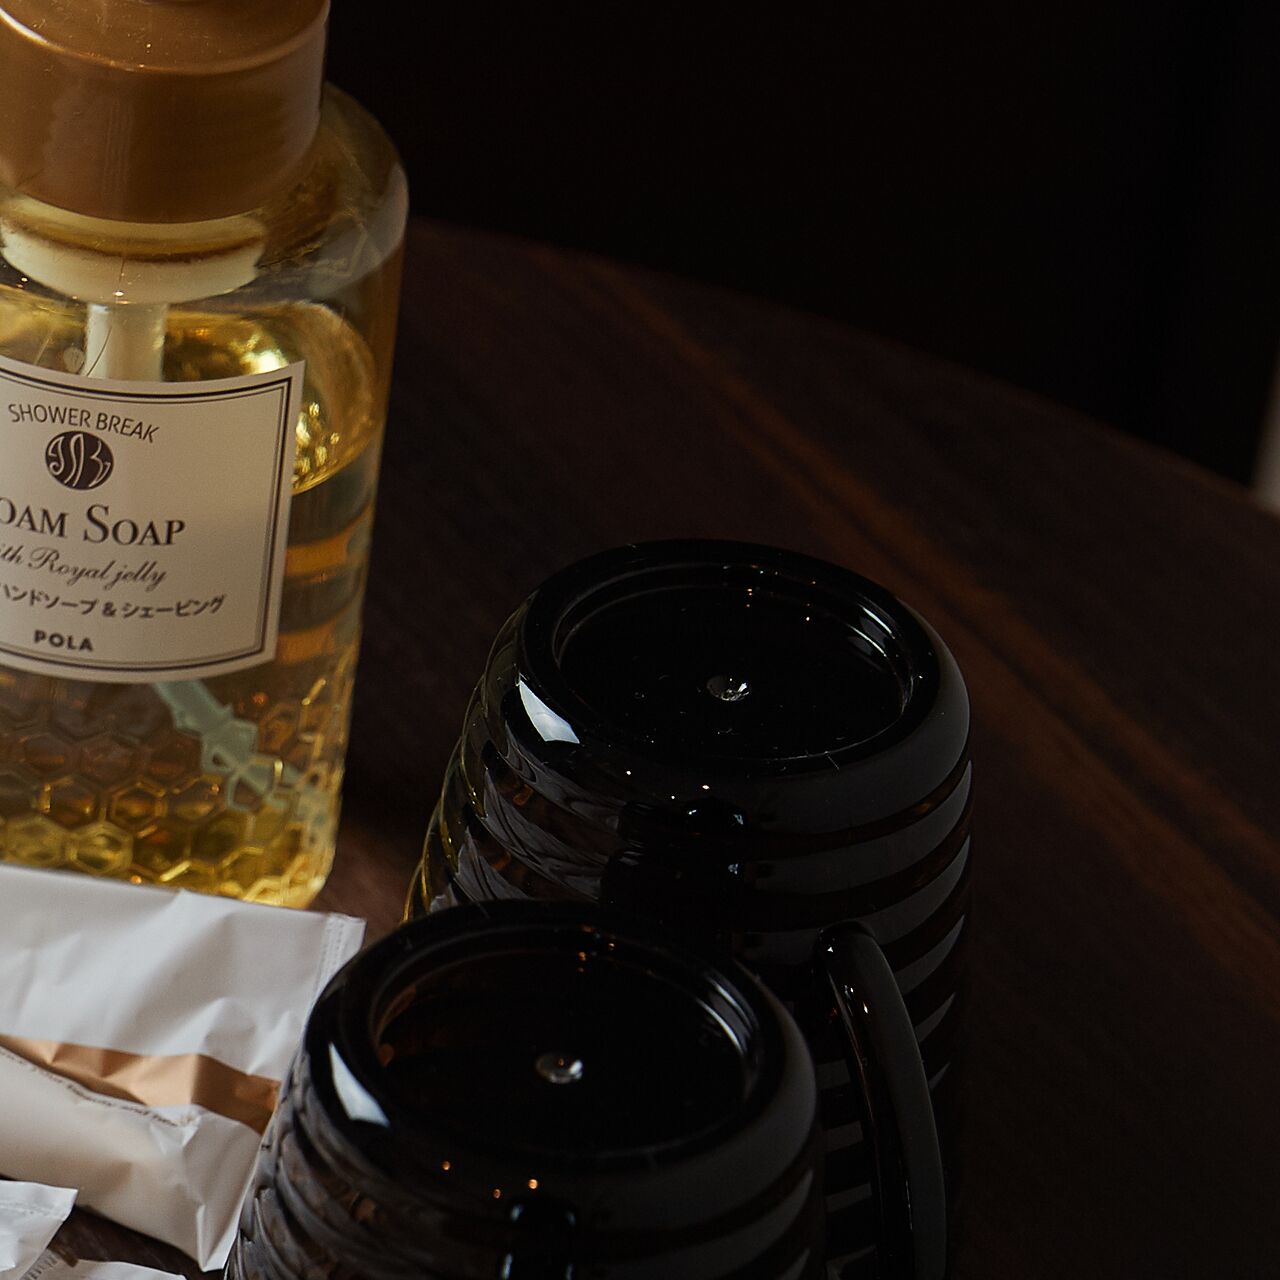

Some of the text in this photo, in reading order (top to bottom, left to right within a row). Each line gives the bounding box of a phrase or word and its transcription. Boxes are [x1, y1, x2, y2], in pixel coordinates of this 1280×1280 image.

[7, 402, 161, 444] SHOWER BREAK
[83, 503, 186, 547] SOAP
[28, 546, 111, 587] Royal
[105, 560, 167, 592] jelly
[34, 629, 95, 652] POLA
